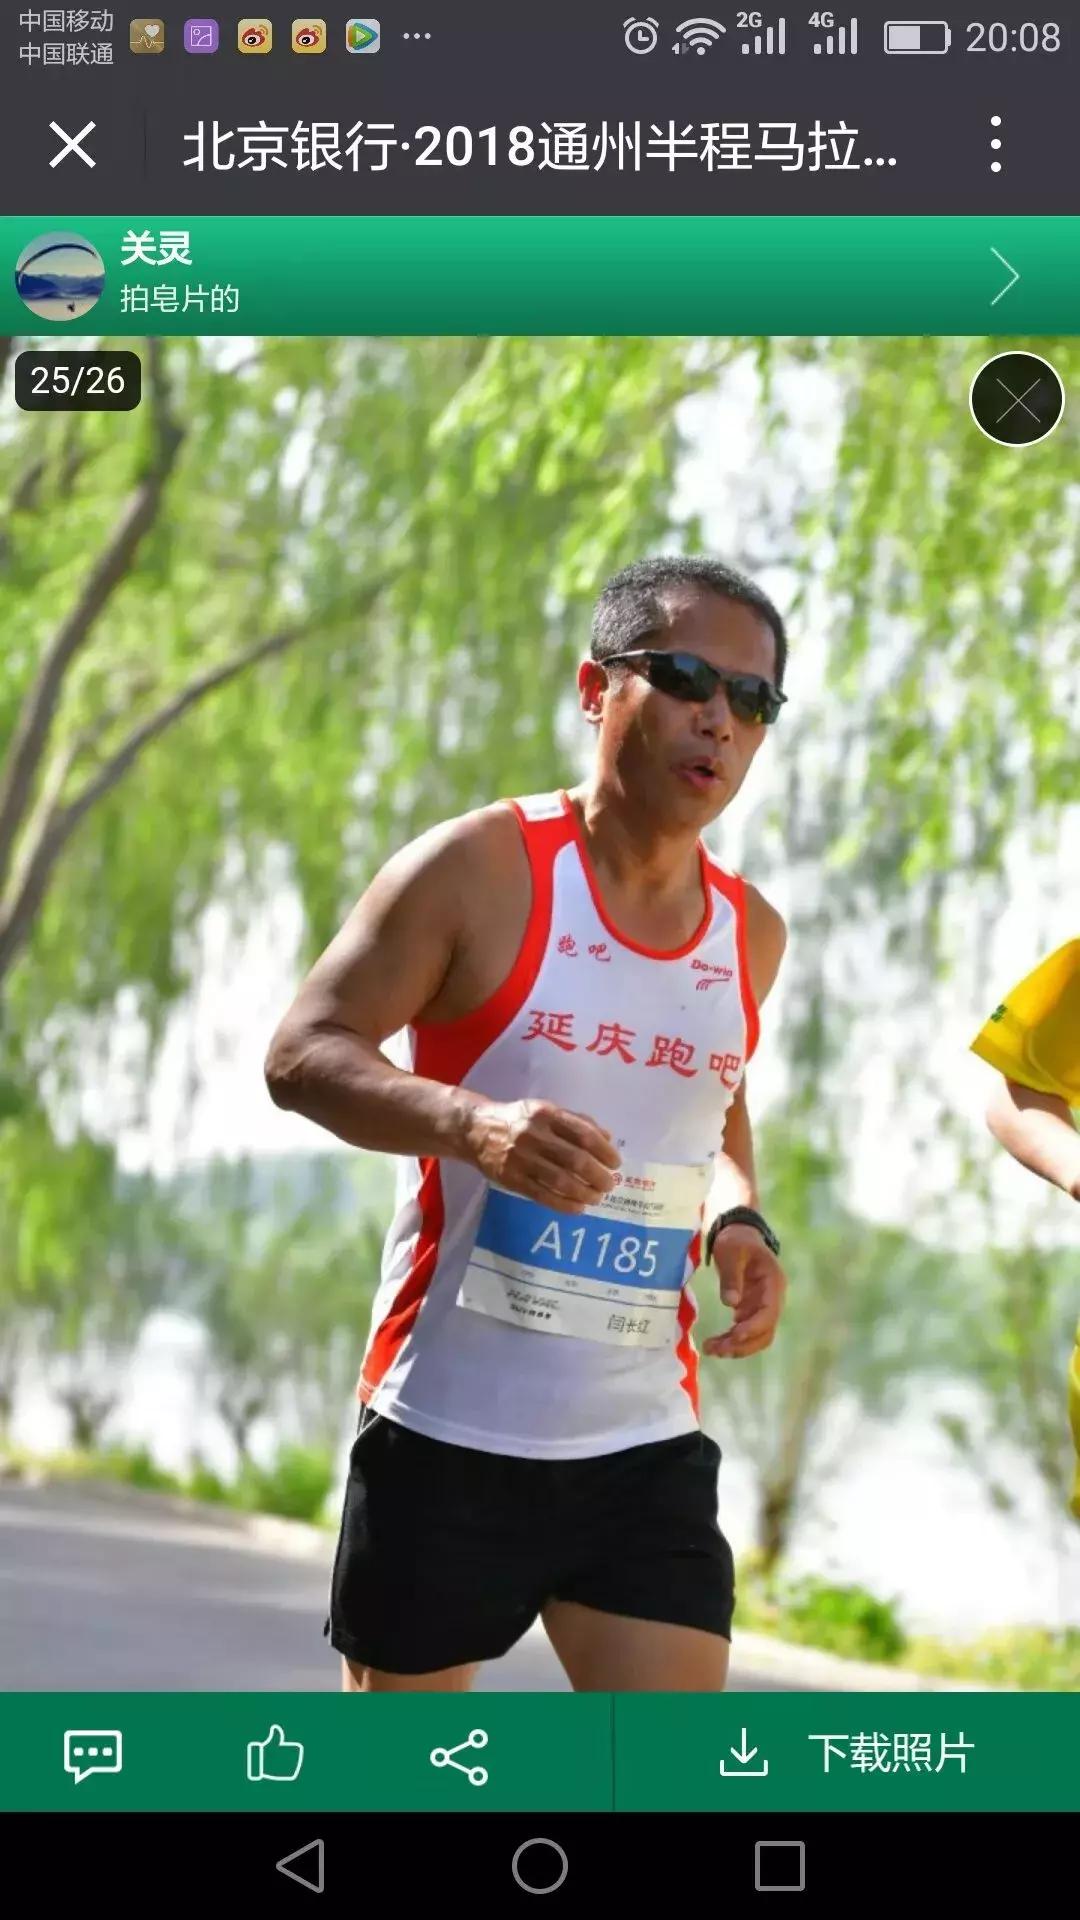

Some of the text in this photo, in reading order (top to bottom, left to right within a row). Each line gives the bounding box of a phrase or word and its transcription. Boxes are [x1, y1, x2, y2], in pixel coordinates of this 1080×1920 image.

[19, 9, 114, 33] 中国移动
[737, 12, 763, 28] 2G
[808, 12, 835, 28] 4G
[966, 22, 1061, 53] 20:08
[19, 42, 114, 66] 中国联通
[120, 229, 193, 266] 关灵
[120, 283, 240, 313] 拍皂片的
[521, 1010, 741, 1091] 延庆跑吧
[530, 1220, 660, 1278] A1185
[807, 1731, 975, 1774] 下载照片
